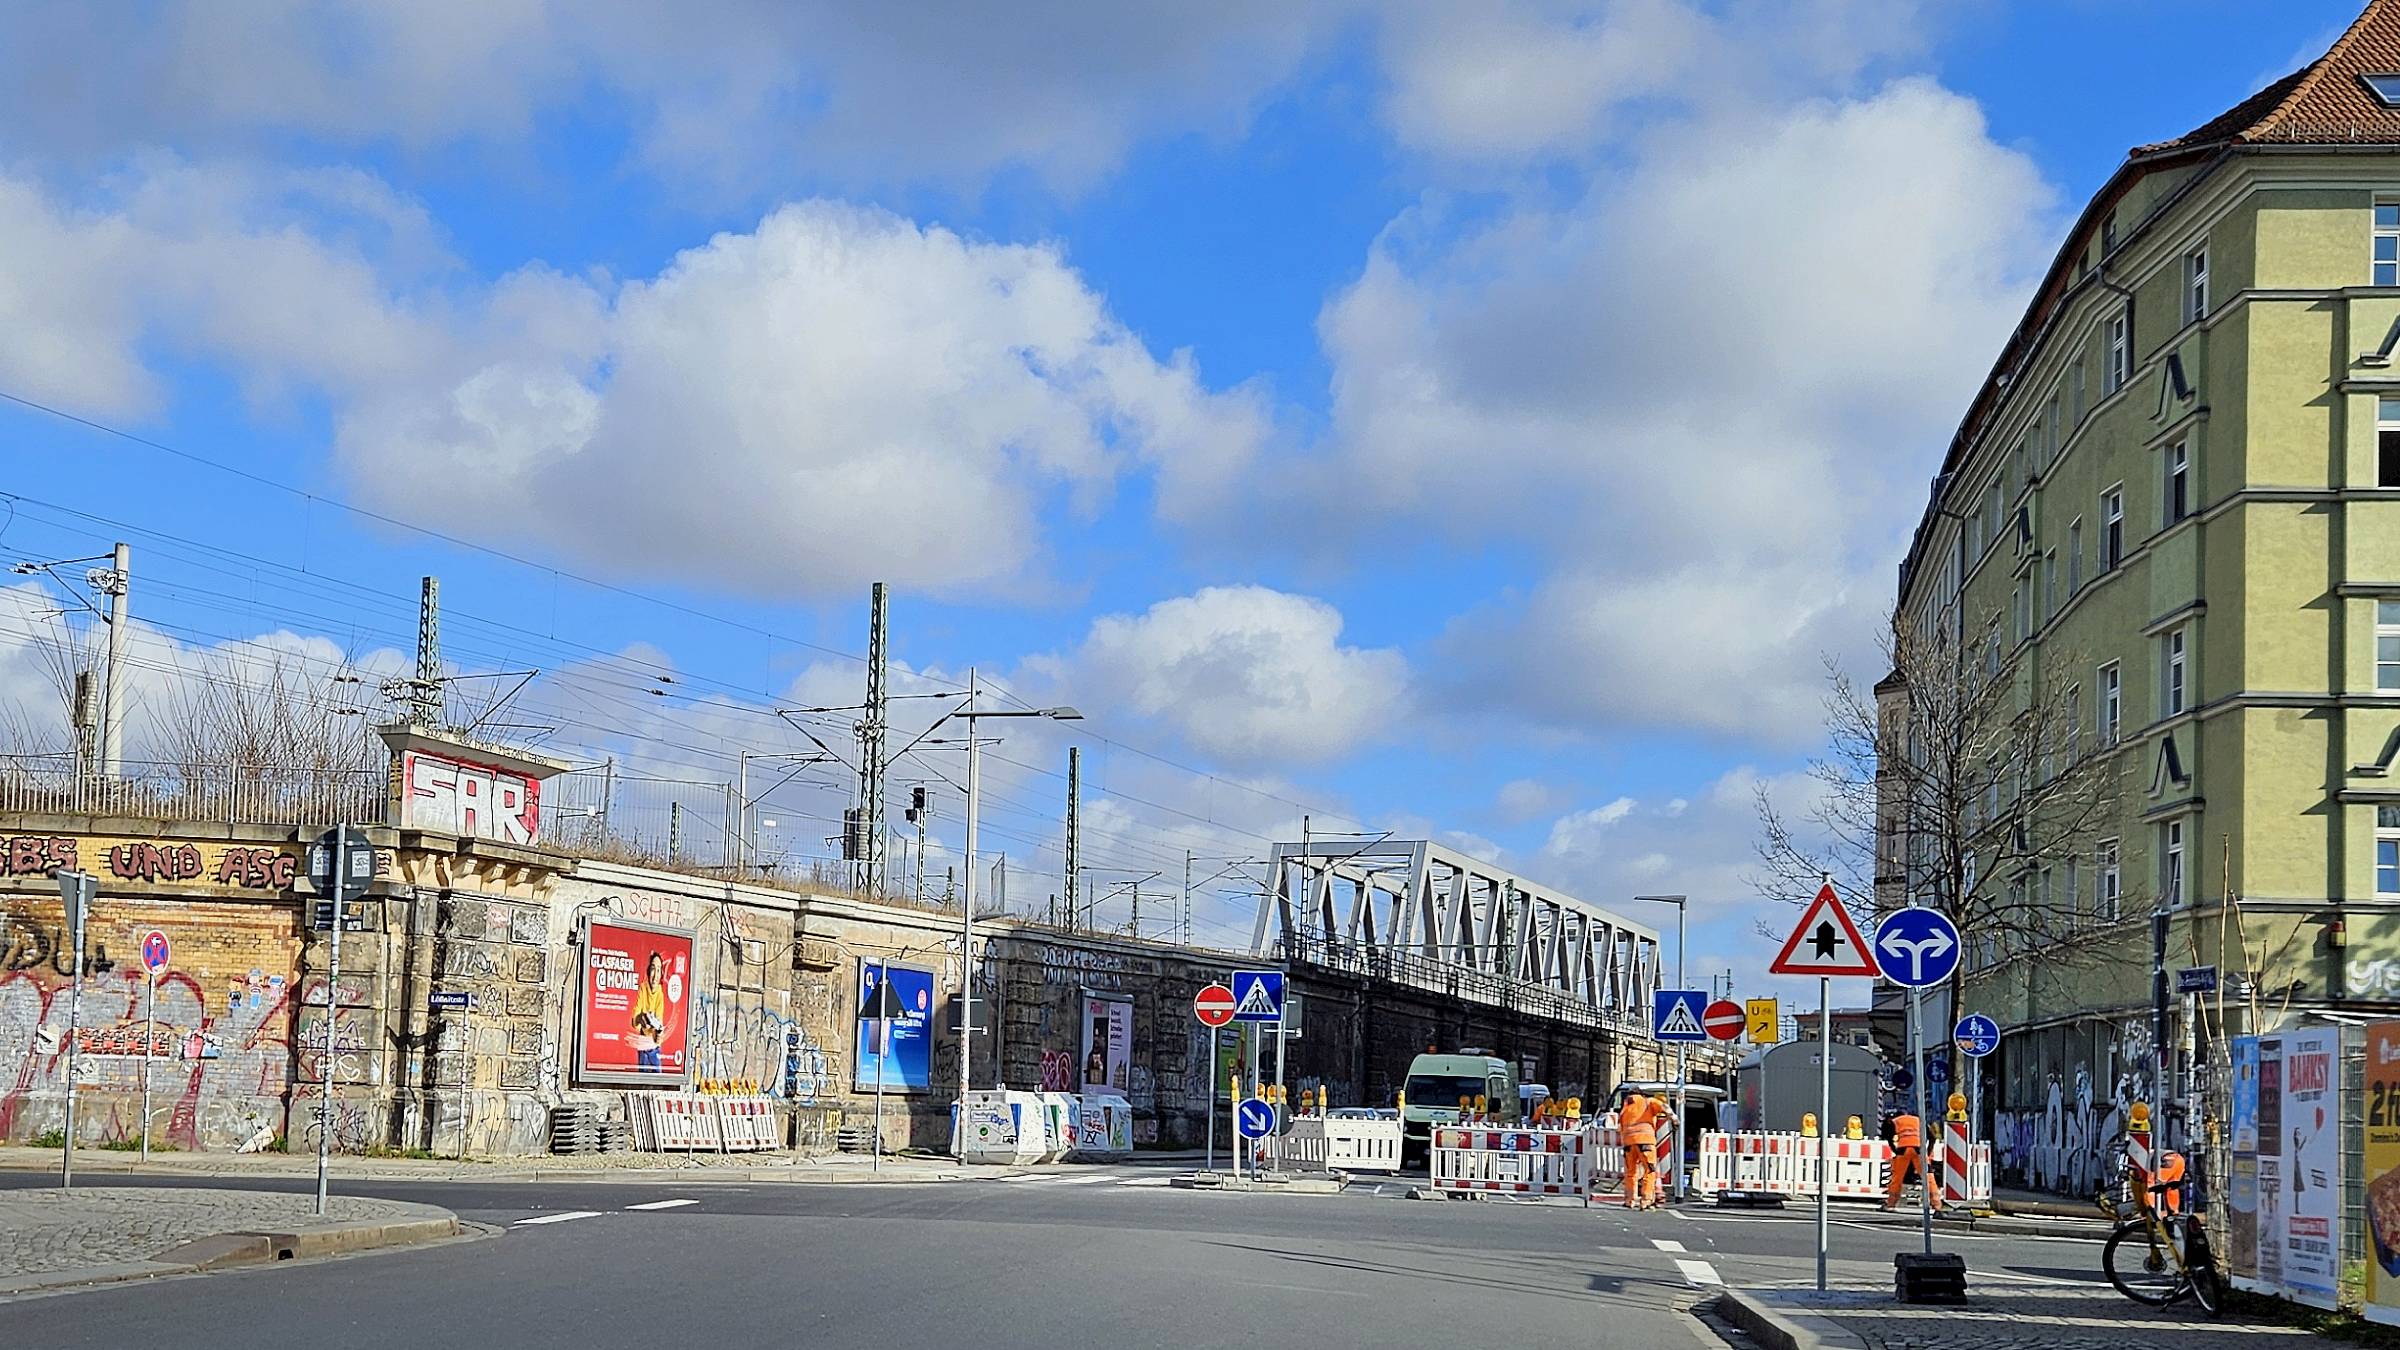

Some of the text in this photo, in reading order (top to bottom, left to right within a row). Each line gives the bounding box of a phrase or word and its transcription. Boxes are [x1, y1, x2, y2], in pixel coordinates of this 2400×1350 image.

[413, 757, 532, 845] SAR
[0, 836, 77, 879] BS
[110, 842, 203, 883] UND
[591, 954, 635, 972] GLASFASER
[596, 968, 640, 991] @HOME
[1752, 1007, 1760, 1016] U
[2289, 1053, 2330, 1093] BANKSY
[2369, 1080, 2385, 1126] 2
